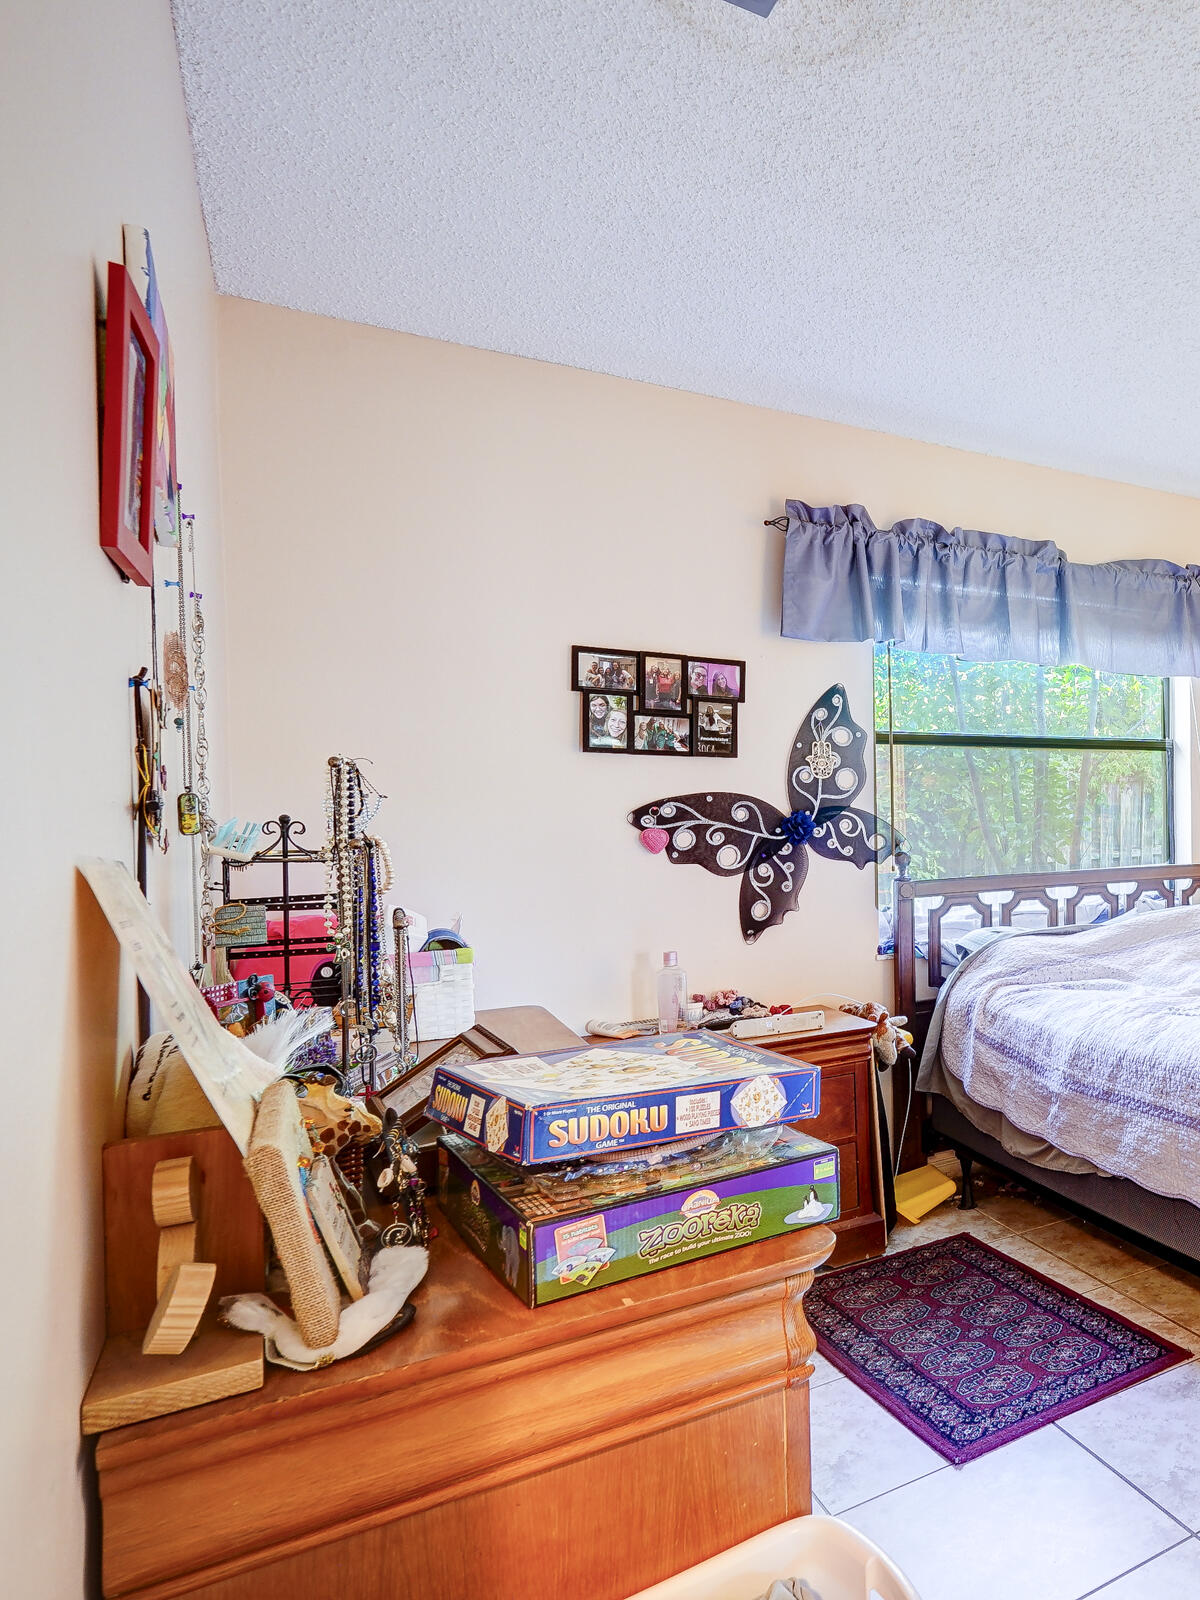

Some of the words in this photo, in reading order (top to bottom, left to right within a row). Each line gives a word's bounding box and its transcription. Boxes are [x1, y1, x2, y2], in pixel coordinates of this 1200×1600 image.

[586, 1106, 601, 1114] THE
[601, 1101, 636, 1112] ORIGINAL
[548, 1104, 668, 1148] SUDOKU
[595, 1139, 618, 1149] GAME
[648, 1257, 660, 1265] The
